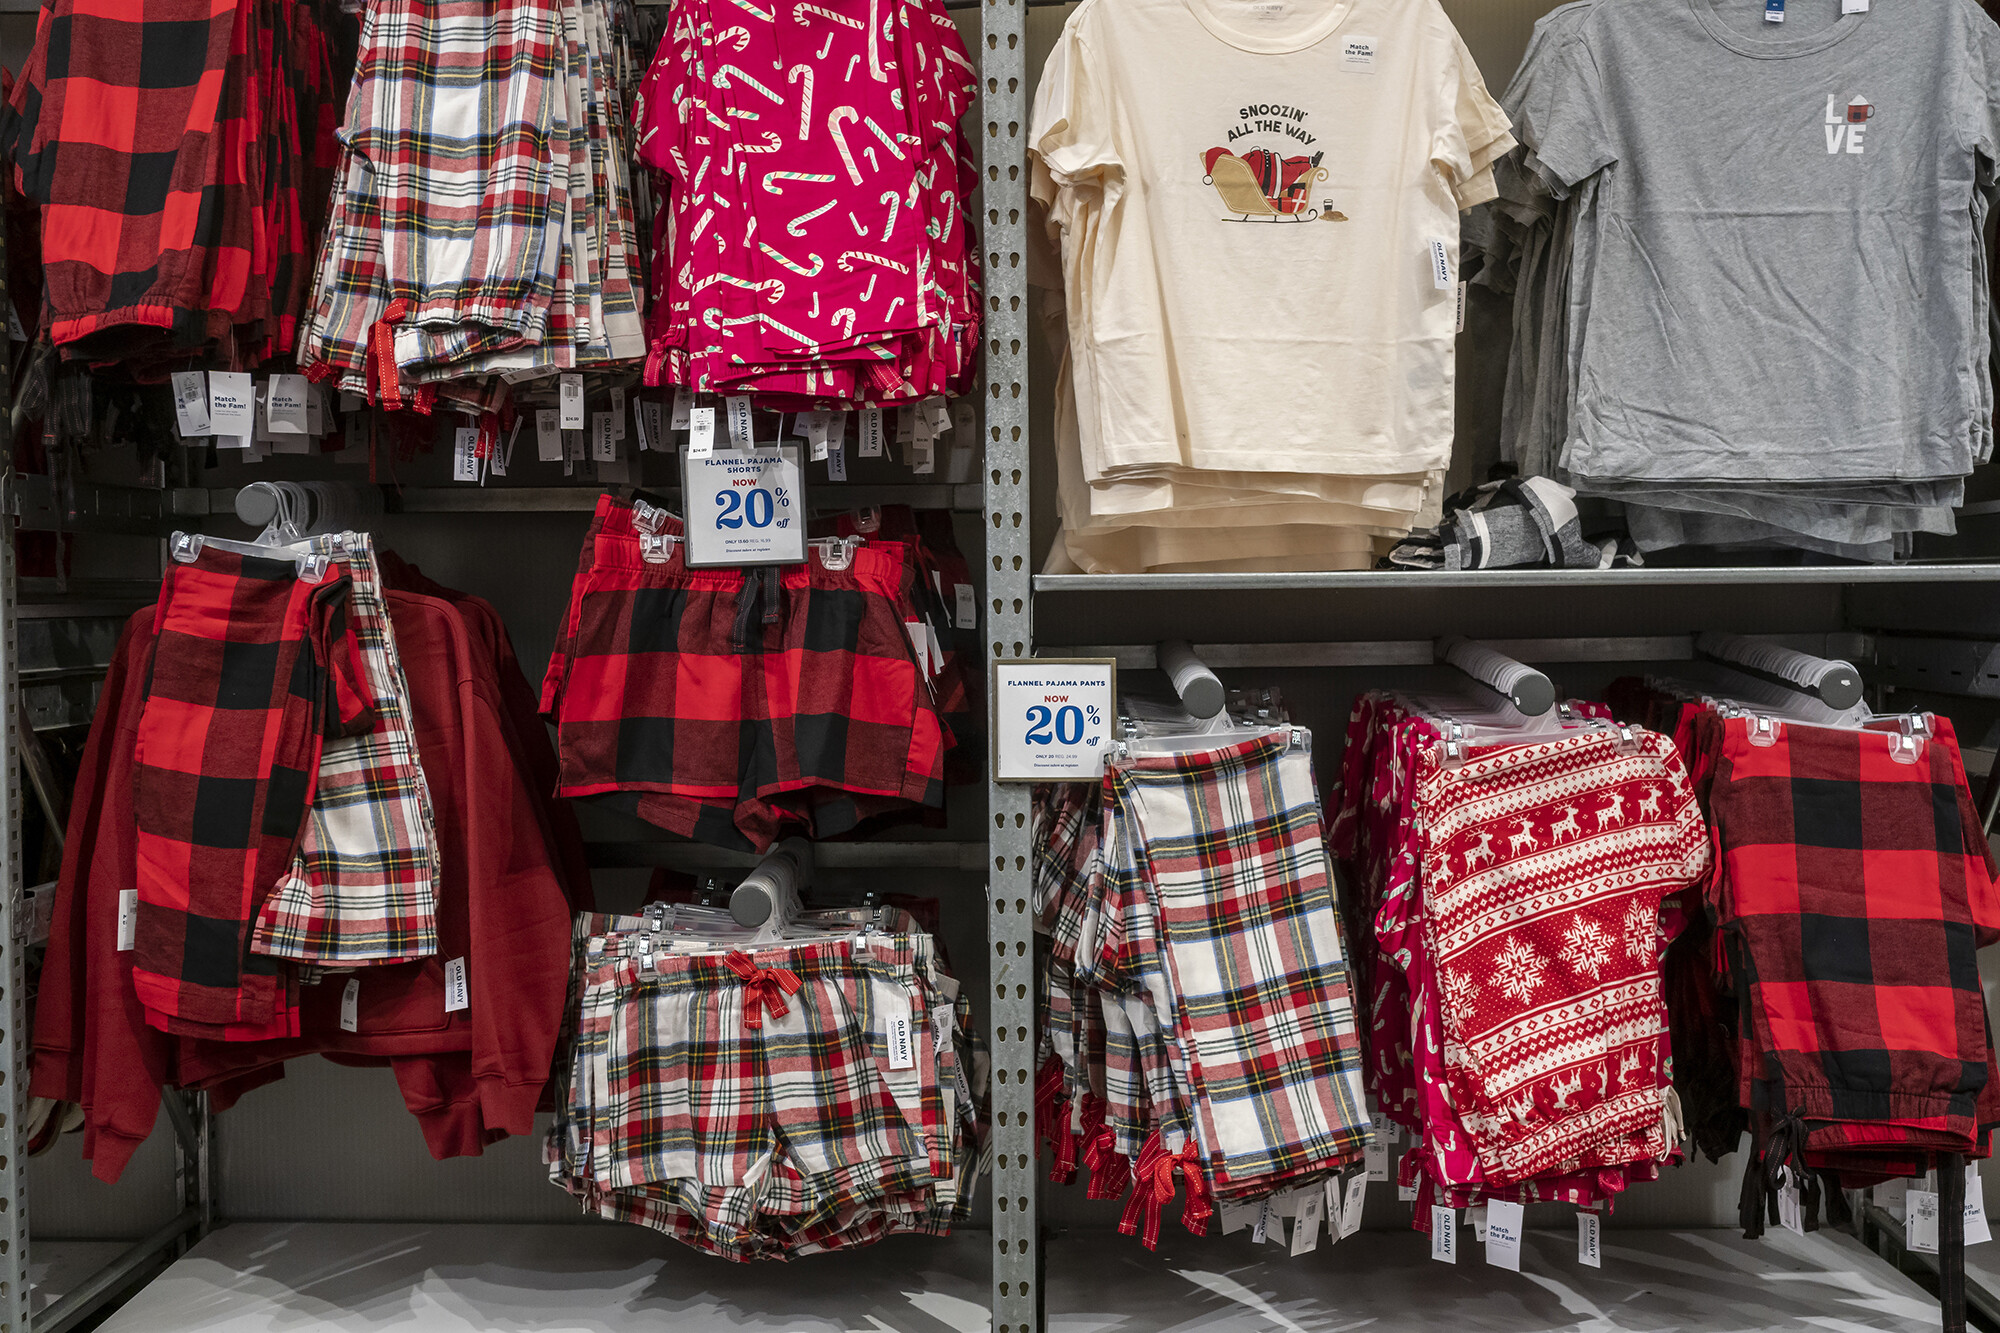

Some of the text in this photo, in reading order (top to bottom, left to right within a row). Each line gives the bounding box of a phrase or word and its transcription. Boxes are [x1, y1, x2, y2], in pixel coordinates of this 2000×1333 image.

[1240, 104, 1308, 122] SNOOZIN'
[1228, 120, 1316, 145] ALL THE WAY
[738, 402, 747, 417] OLD
[776, 518, 790, 528] off
[1086, 736, 1100, 746] off
[899, 1038, 908, 1061] NAVY
[1490, 1224, 1509, 1234] Match
[1501, 1234, 1517, 1243] Fam!
